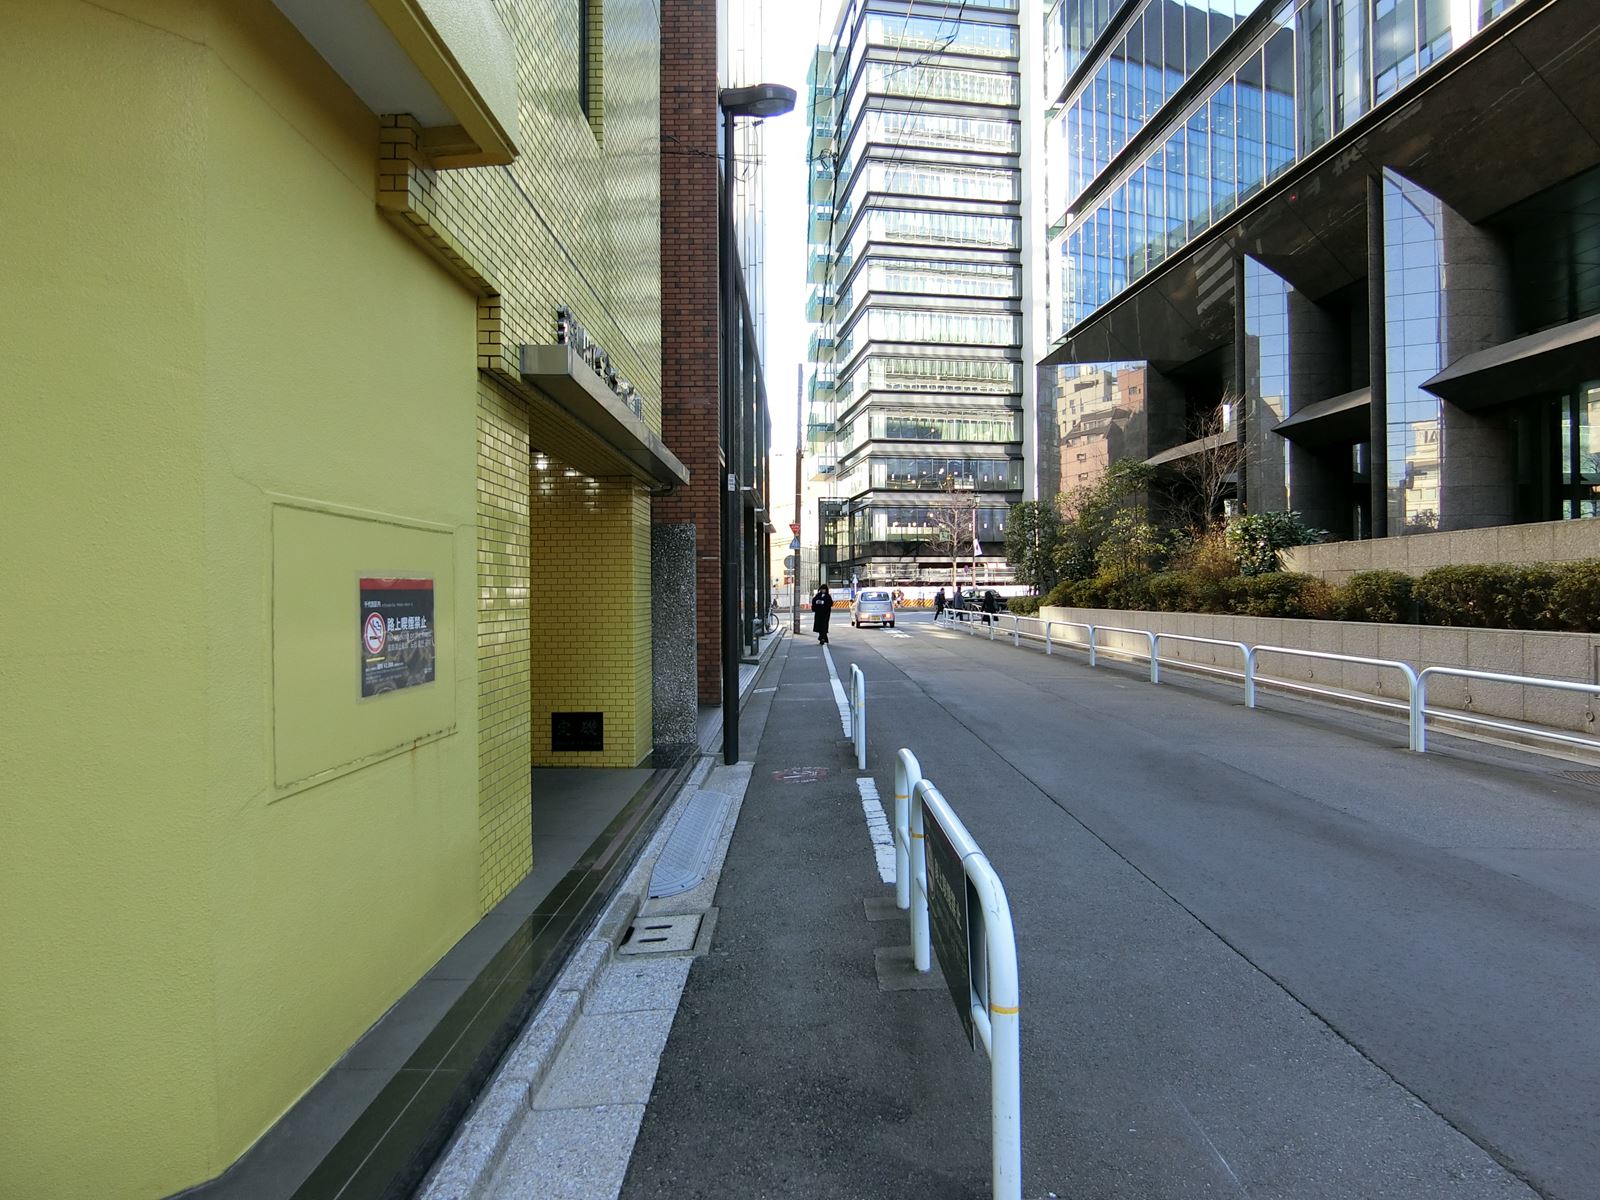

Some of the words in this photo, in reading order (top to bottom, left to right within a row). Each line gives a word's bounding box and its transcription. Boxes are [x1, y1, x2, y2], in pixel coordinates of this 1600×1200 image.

[387, 615, 427, 632] 路上喫煙禁止
